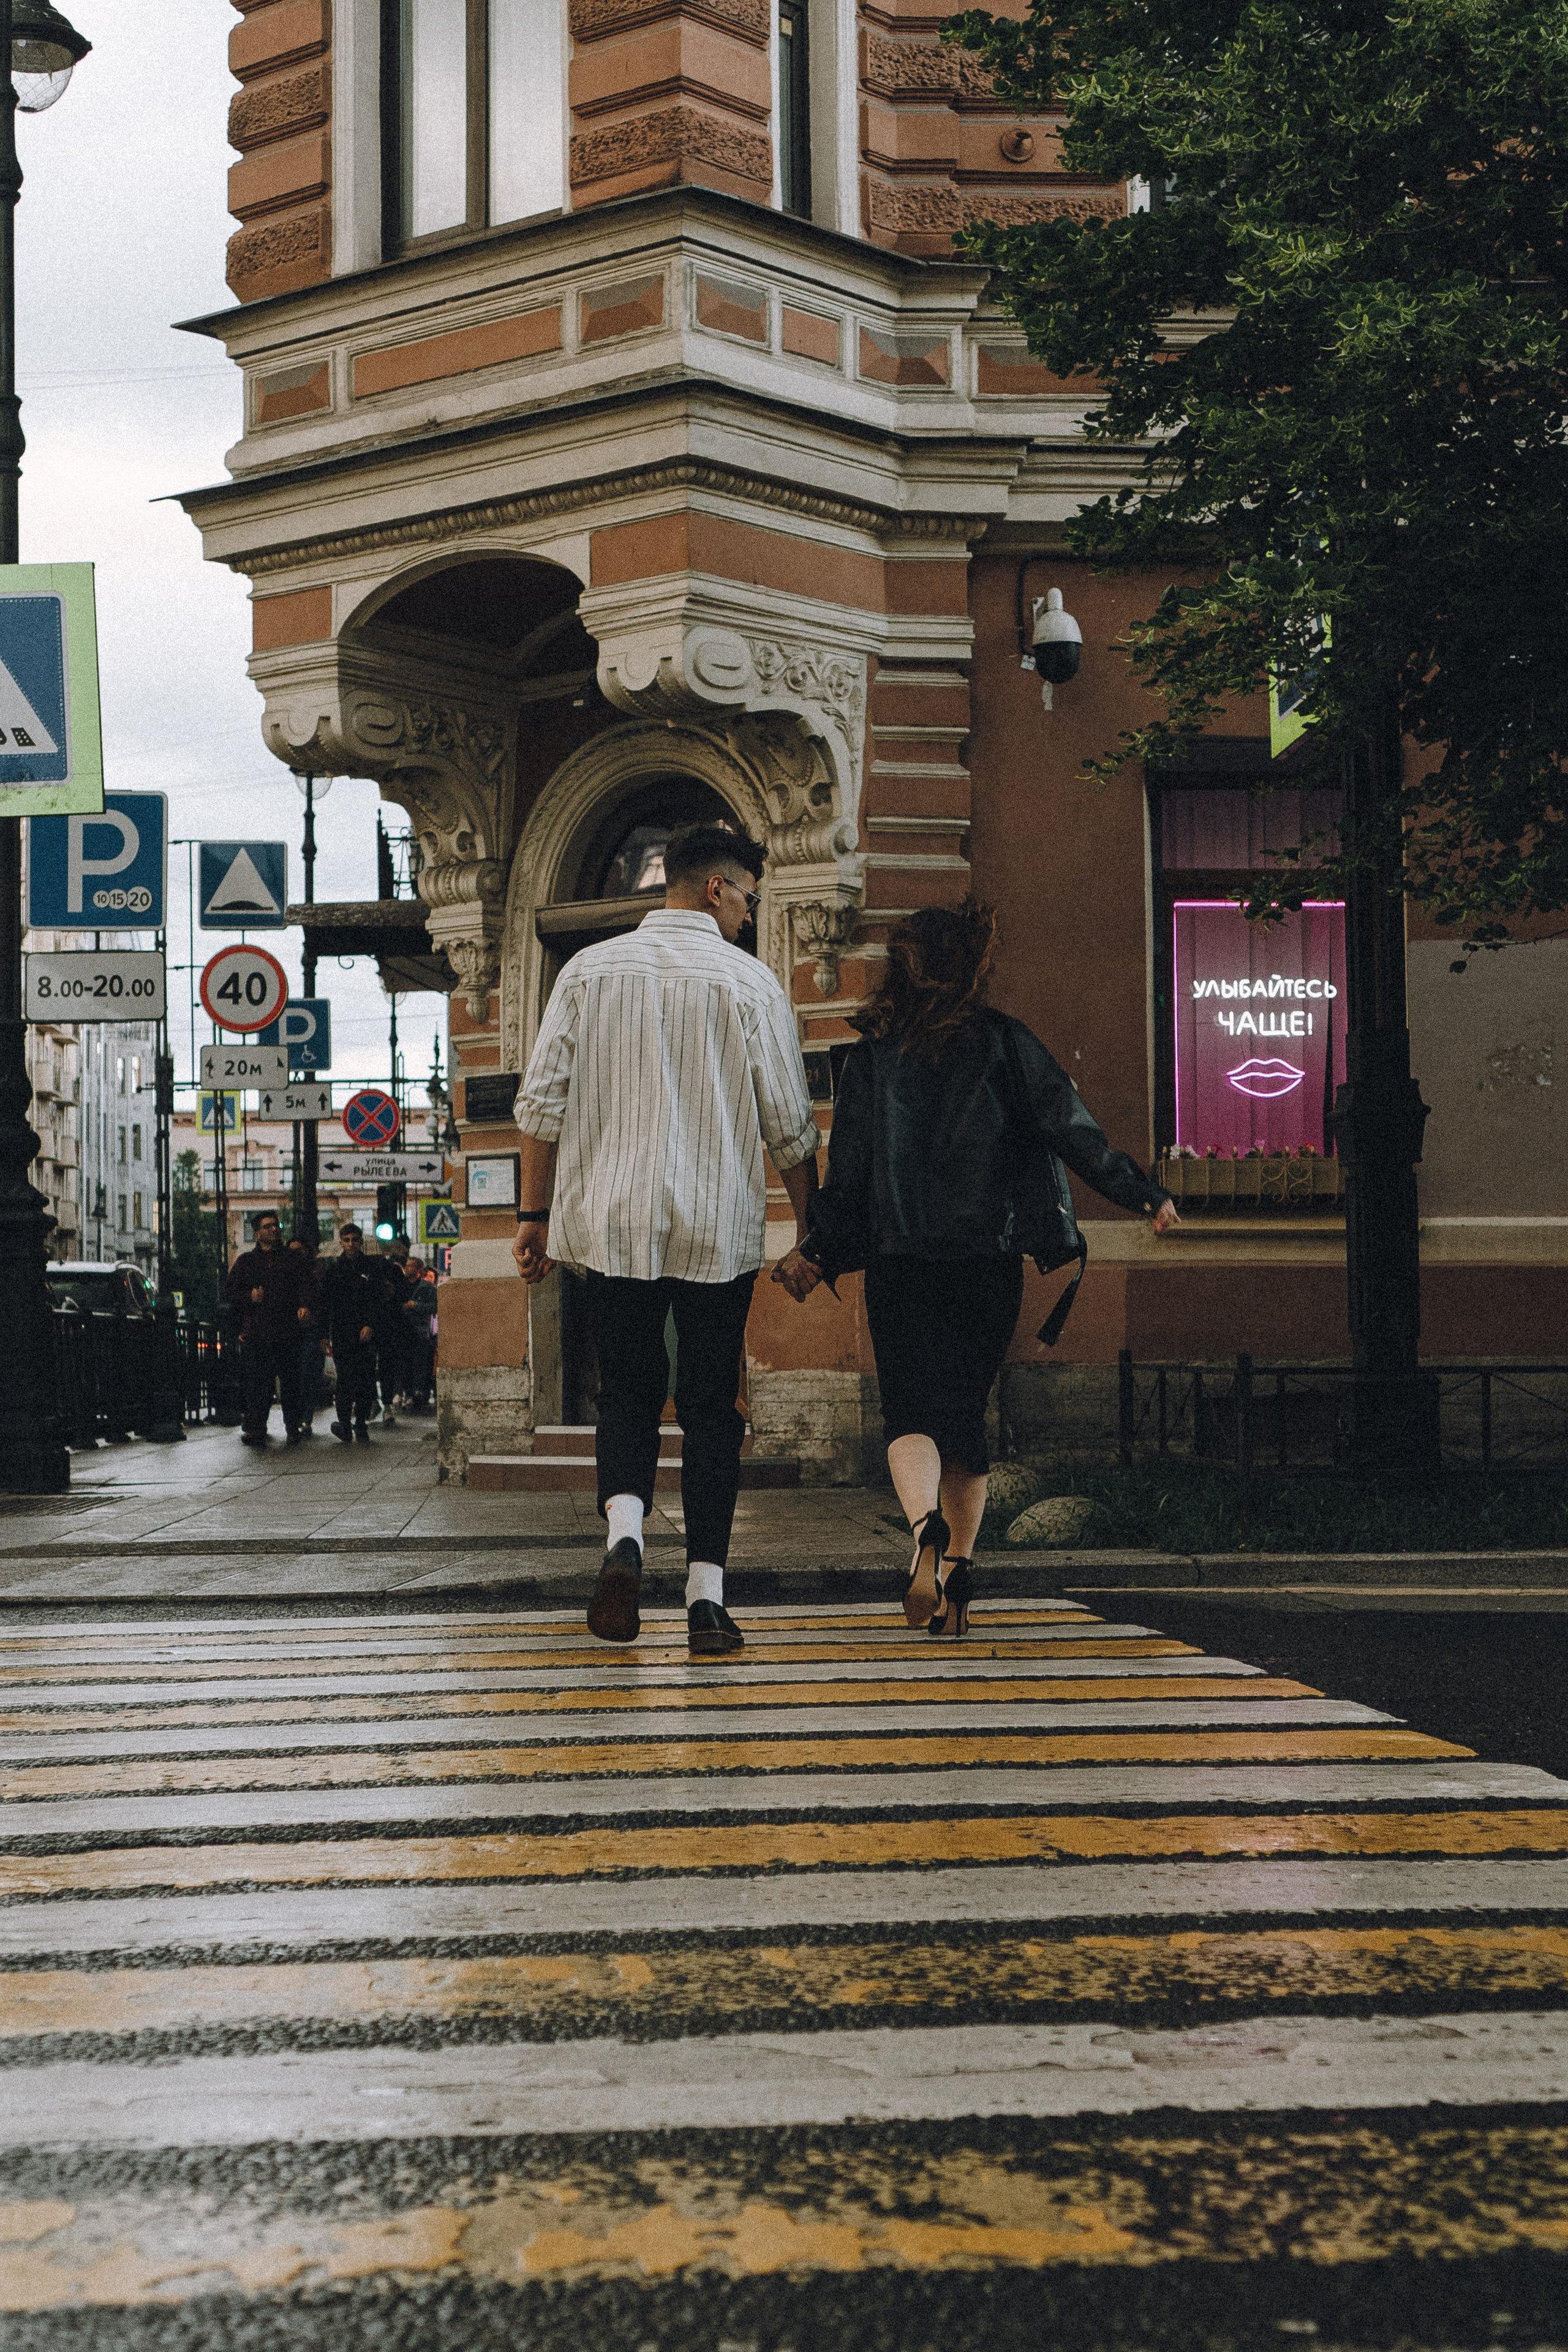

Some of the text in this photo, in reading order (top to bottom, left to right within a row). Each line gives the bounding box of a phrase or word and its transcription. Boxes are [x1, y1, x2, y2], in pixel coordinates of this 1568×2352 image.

[67, 809, 140, 913] P
[97, 892, 150, 907] 10 15 20
[37, 974, 155, 998] 8.00-20.00
[216, 971, 267, 1006] 40
[1193, 973, 1338, 999] УЛЫБАЙТЕСЬ
[278, 1008, 317, 1045] P
[1218, 1011, 1313, 1038] ЧАЩЕ!
[353, 1166, 407, 1176] РЫЛЕЕВА
[366, 1158, 396, 1166] улица
